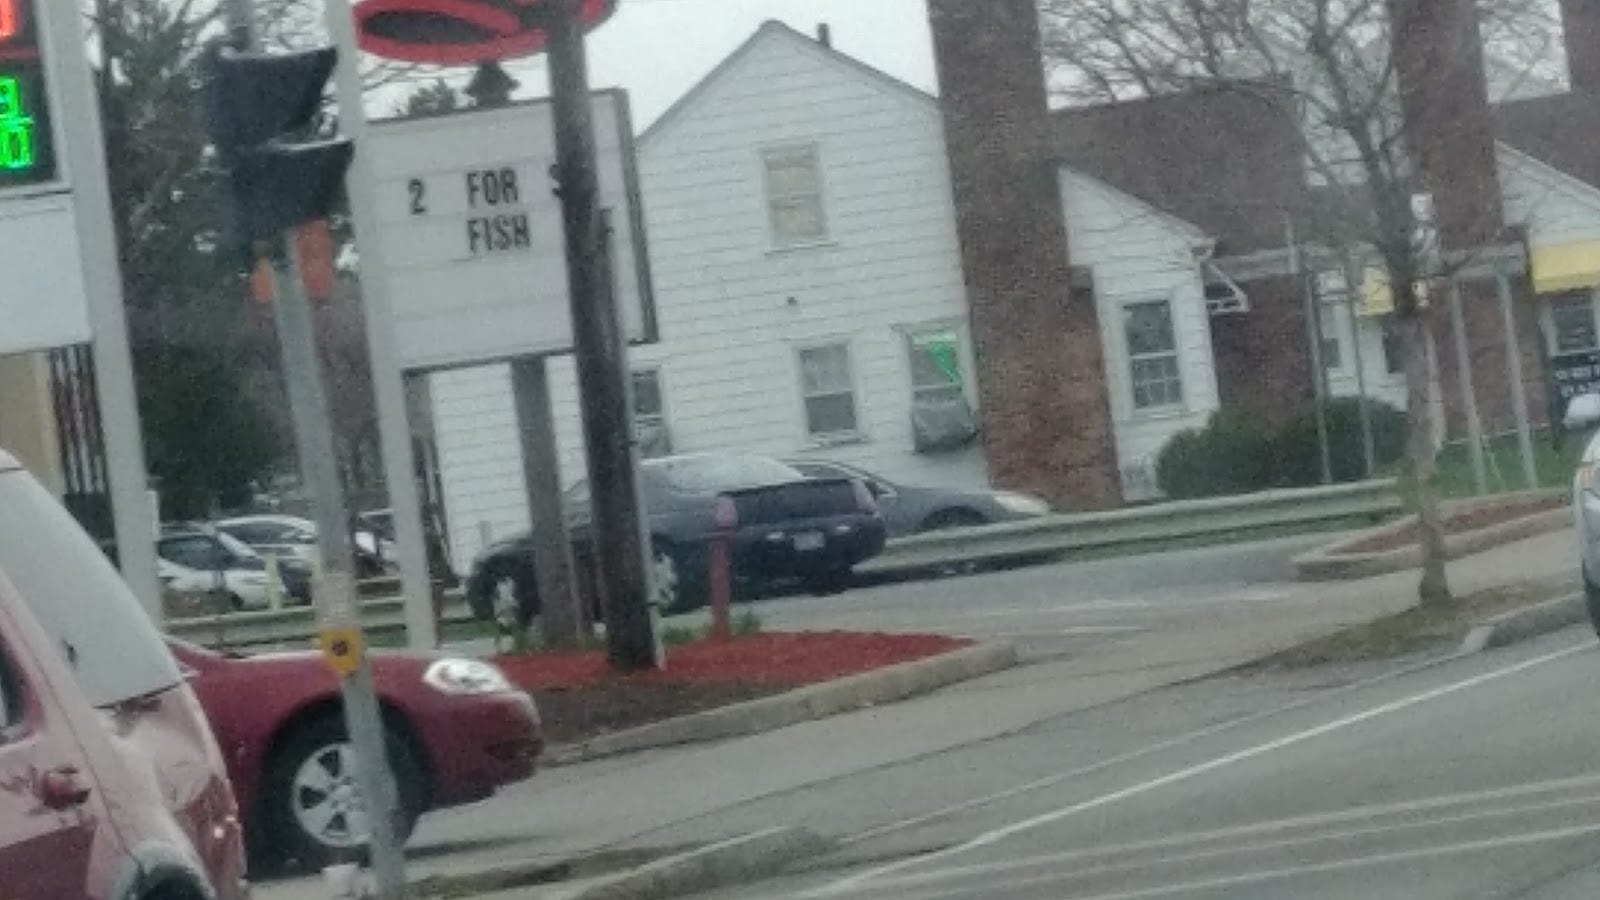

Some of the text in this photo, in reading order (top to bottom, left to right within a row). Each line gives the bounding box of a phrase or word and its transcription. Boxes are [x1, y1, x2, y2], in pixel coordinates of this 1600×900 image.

[408, 178, 426, 215] 2
[466, 167, 519, 207] FOR
[466, 214, 531, 253] FISH
